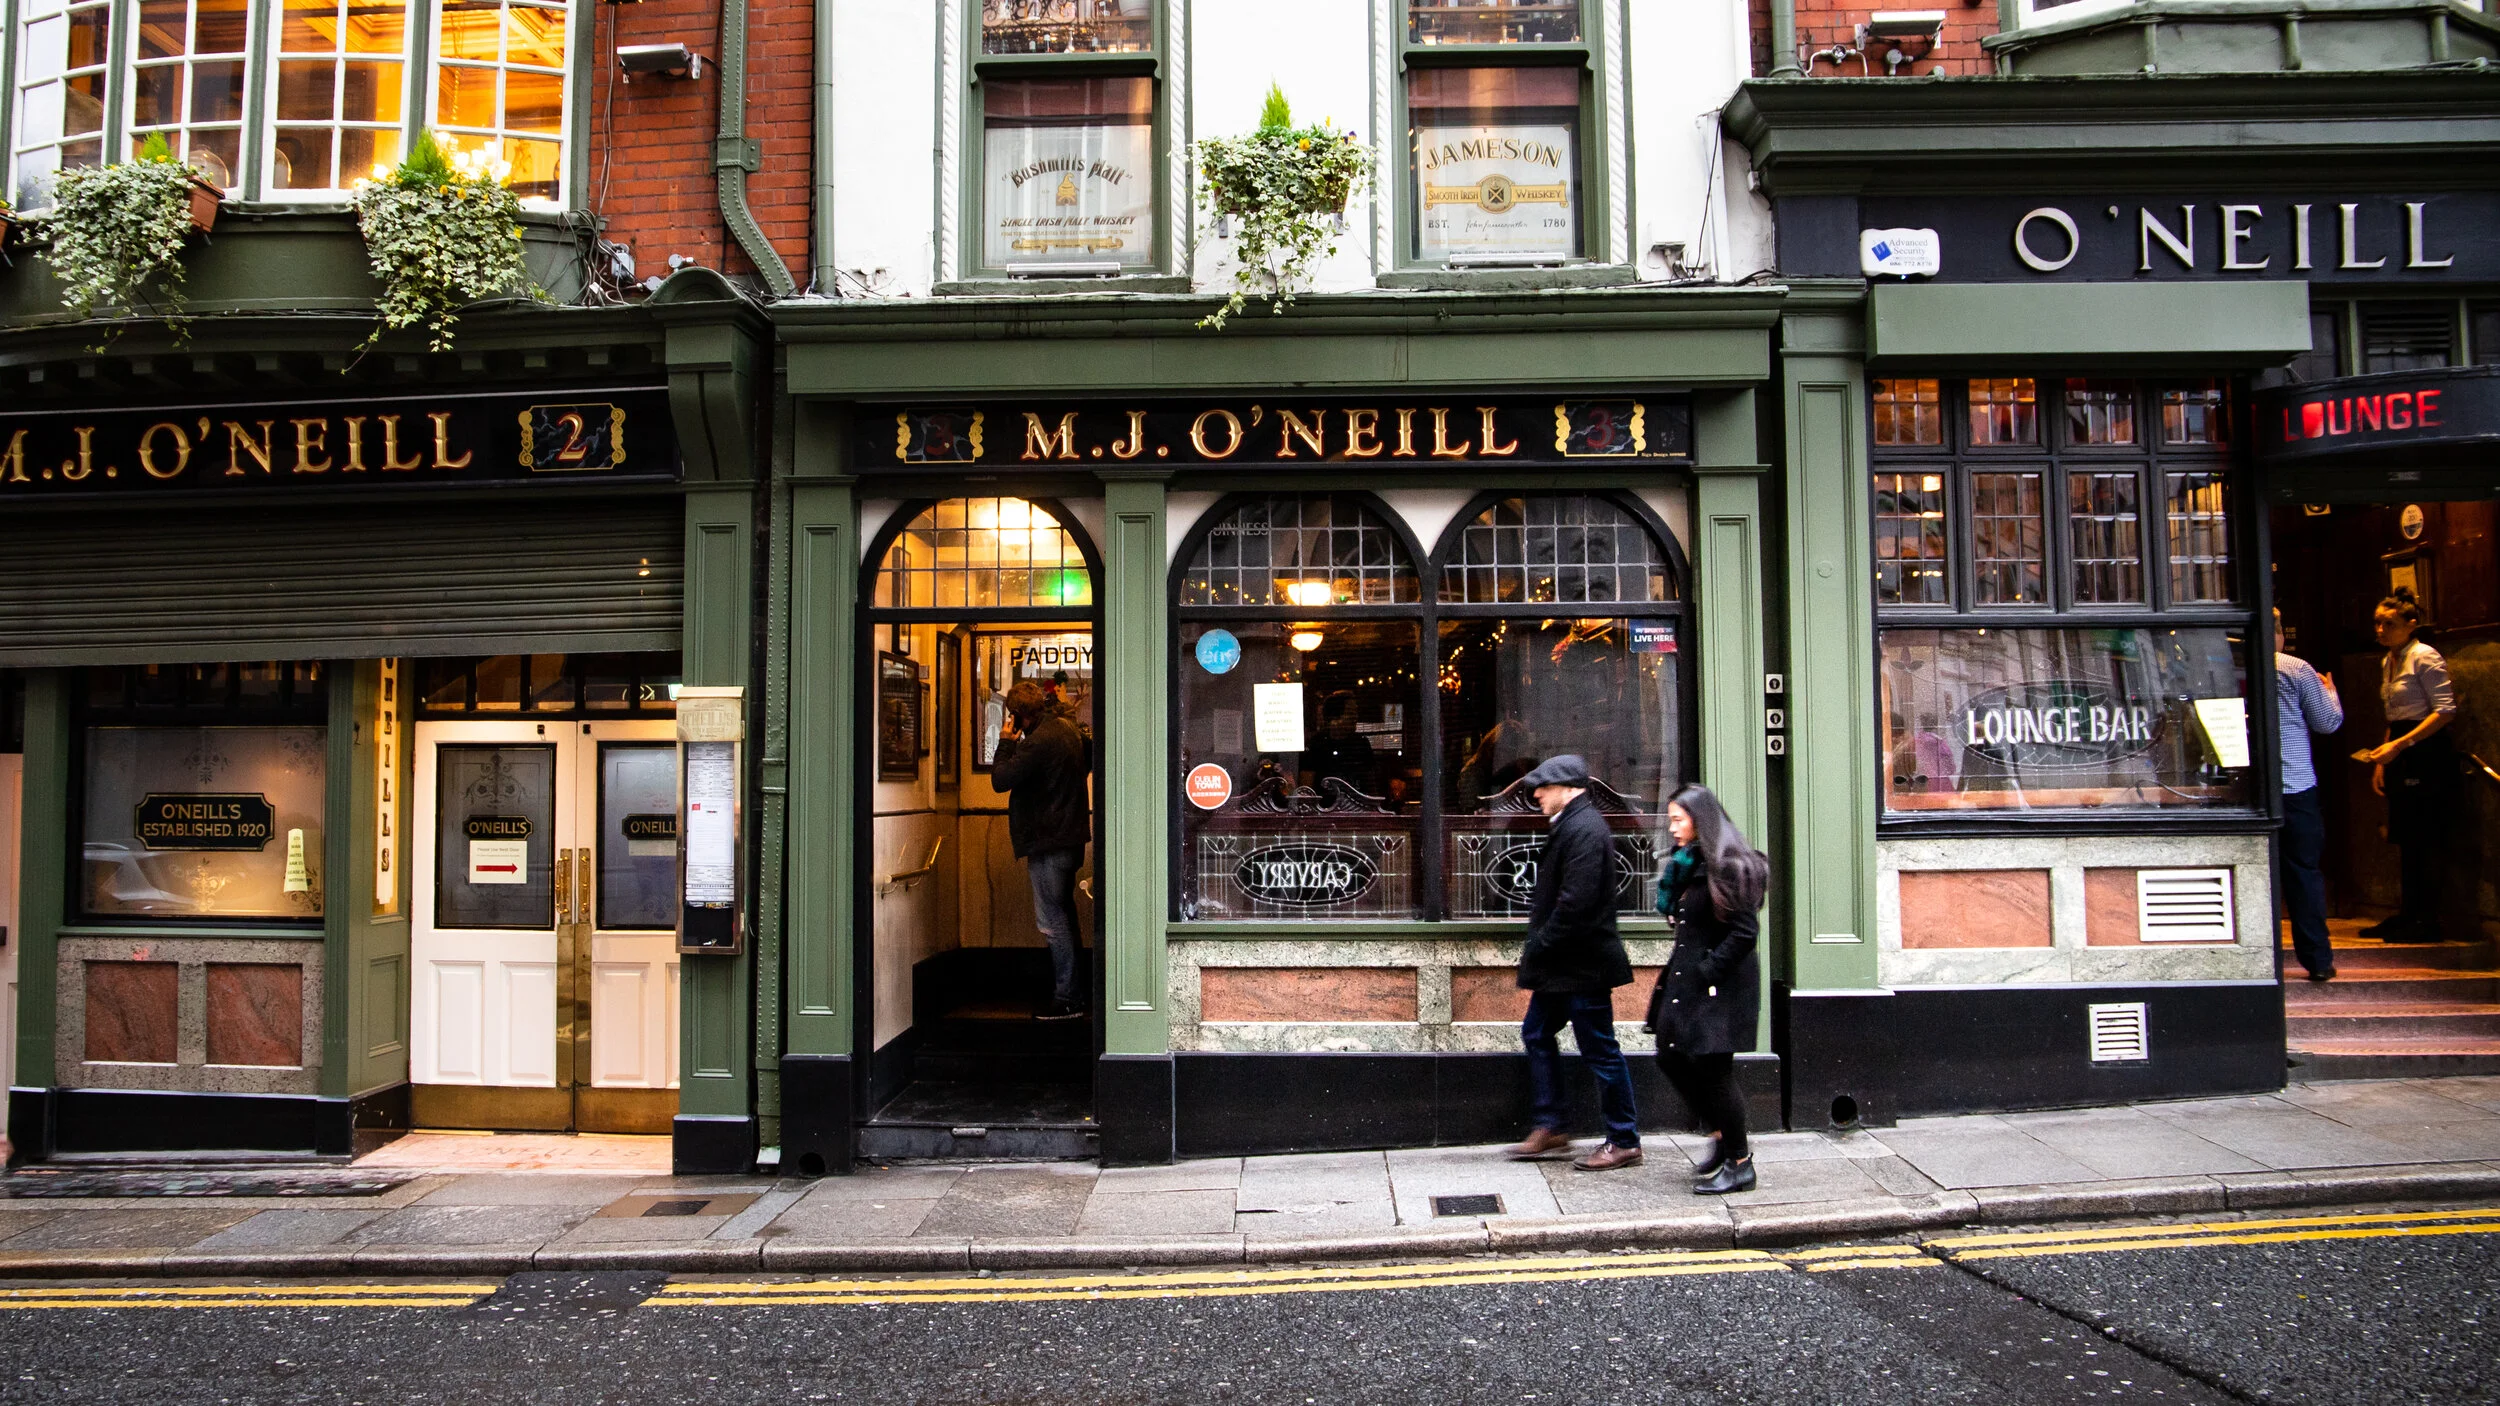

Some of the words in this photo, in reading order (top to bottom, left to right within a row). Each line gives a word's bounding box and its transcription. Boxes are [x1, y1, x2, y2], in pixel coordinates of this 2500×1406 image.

[1426, 138, 1562, 170] JAMESON
[1428, 191, 1458, 201] SMOOTH
[1460, 191, 1478, 200] IRISH
[1516, 189, 1561, 199] WHISKEY
[1094, 215, 1136, 226] WHISKEY
[1543, 219, 1566, 228] 1780
[1889, 238, 1928, 247] Advanced
[2014, 202, 2455, 272] O'NEILL
[1893, 247, 1925, 256] Security
[2283, 389, 2443, 442] LOUNGE
[1021, 409, 1170, 460] M.J.
[1189, 403, 1519, 459] O'NEILL
[1586, 407, 1616, 450] 3
[137, 411, 473, 479] O'NEILL
[555, 412, 588, 461] 2
[1212, 522, 1268, 536] UINNESS
[1634, 634, 1652, 642] LIVE
[1653, 634, 1675, 642] HERE
[1967, 706, 2084, 745] LOUNGE
[2089, 705, 2152, 742] BAR
[161, 803, 242, 820] O'NEILL'S
[237, 823, 265, 838] 1920
[468, 821, 528, 834] O'NEILL'S
